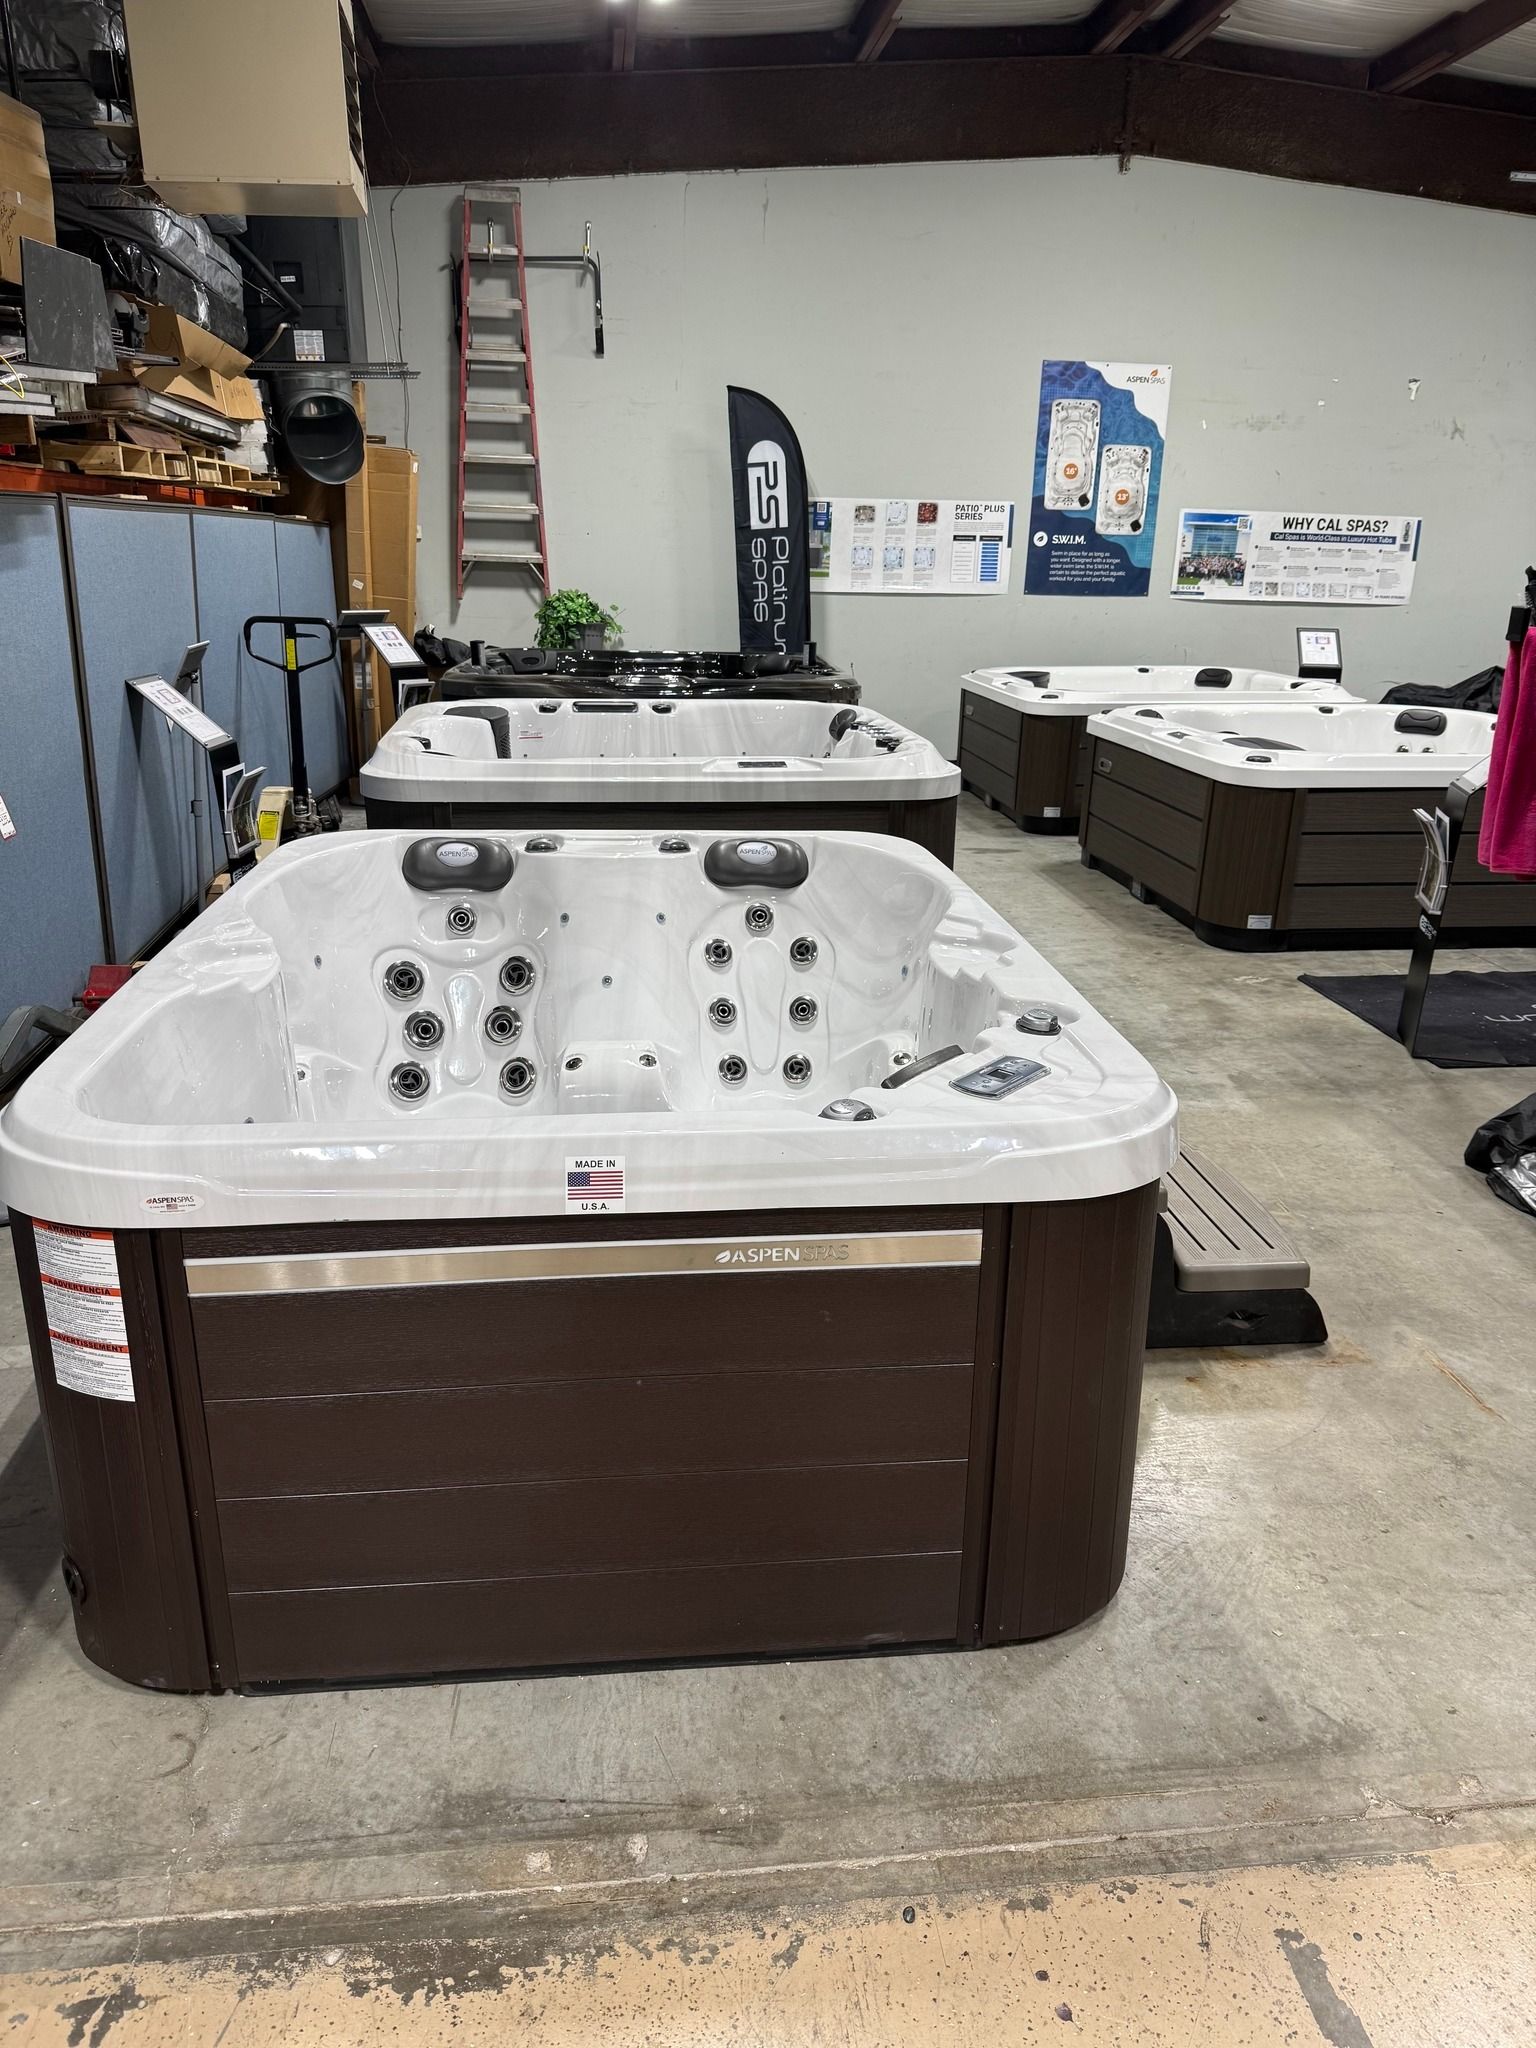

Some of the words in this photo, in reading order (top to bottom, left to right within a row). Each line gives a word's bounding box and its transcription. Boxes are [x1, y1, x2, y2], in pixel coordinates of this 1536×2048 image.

[954, 512, 983, 520] SERIES
[1283, 516, 1314, 530] WHY
[1317, 518, 1343, 531] CAL
[1346, 519, 1389, 533] SPAS?
[1051, 535, 1087, 544] S.W.I.M.
[1285, 533, 1299, 541] Spas
[1306, 534, 1340, 542] World-Class
[1347, 536, 1367, 544] Luxury
[575, 1160, 603, 1168] MADE
[606, 1159, 616, 1168] IN
[152, 1196, 177, 1204] ASPEN
[177, 1195, 194, 1203] SPAS
[581, 1202, 610, 1211] U.S.A.
[52, 1225, 92, 1238] WARNING
[731, 1247, 800, 1263] ASPEN
[802, 1244, 849, 1262] SPAS
[53, 1278, 111, 1295] ADVERTENCIA
[58, 1333, 124, 1353] AVERTISSEMENT
